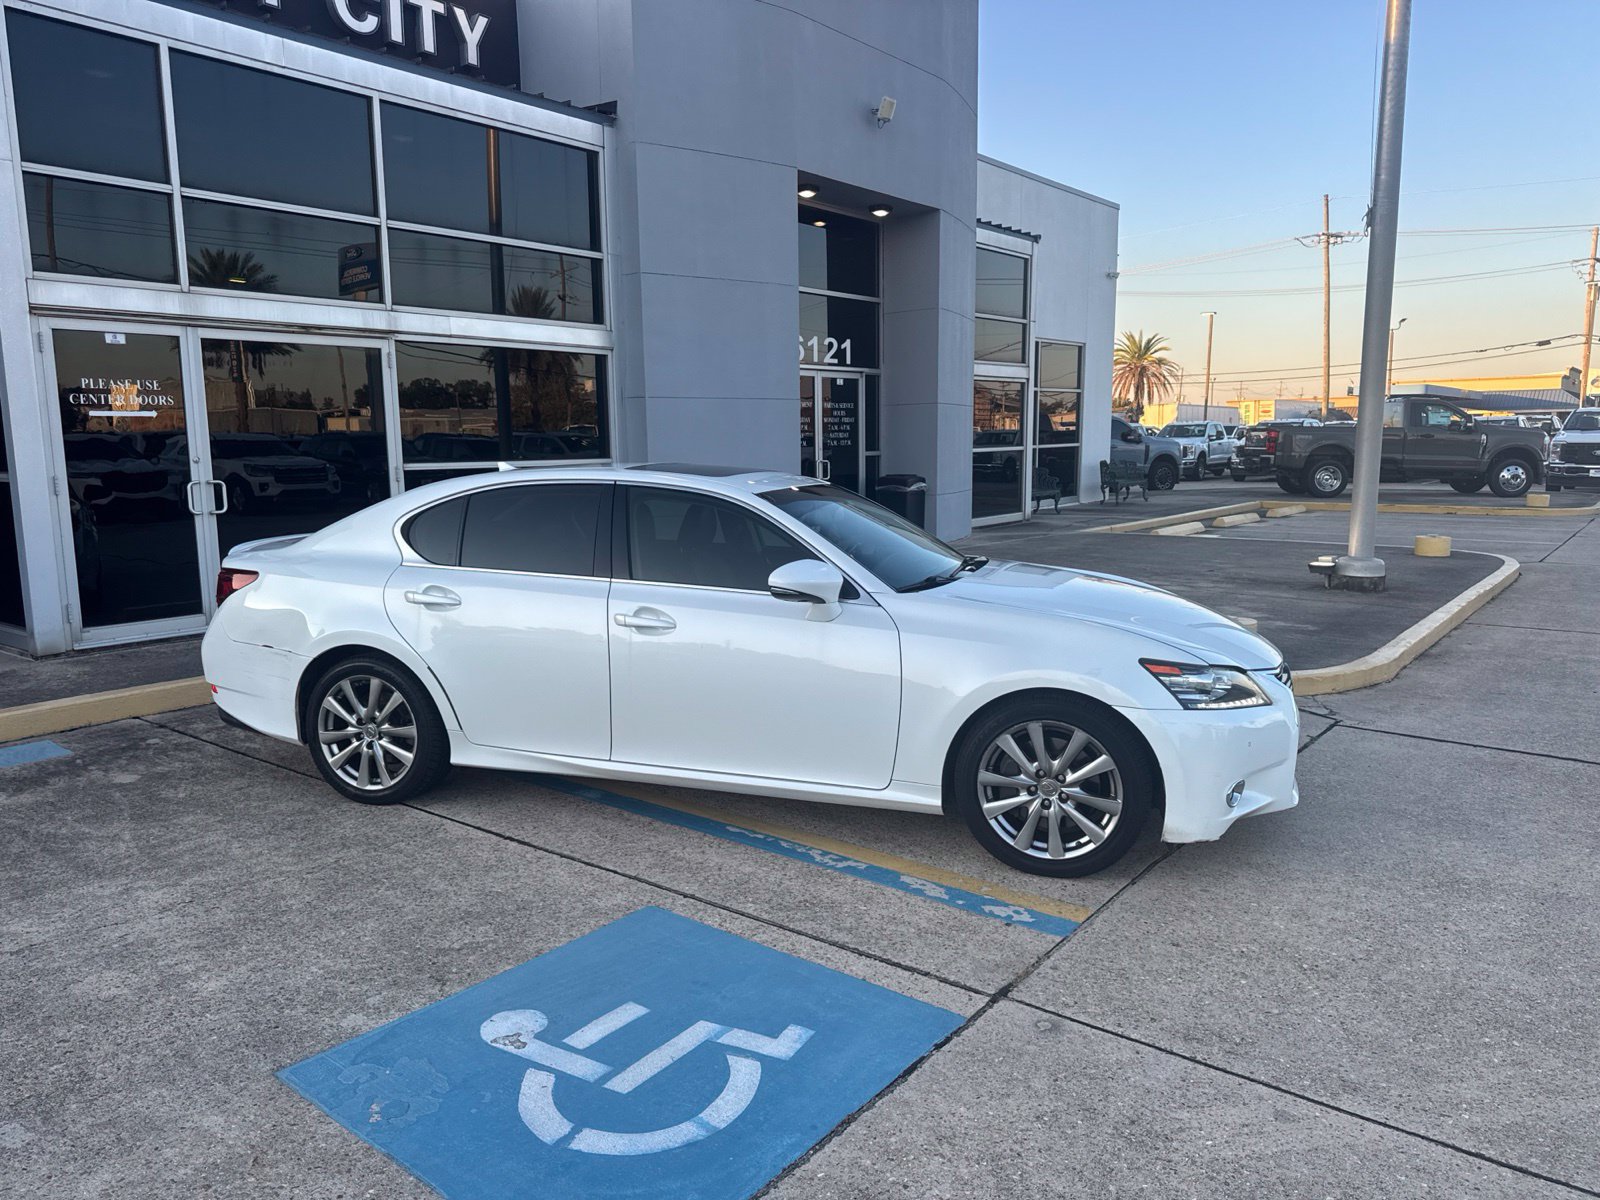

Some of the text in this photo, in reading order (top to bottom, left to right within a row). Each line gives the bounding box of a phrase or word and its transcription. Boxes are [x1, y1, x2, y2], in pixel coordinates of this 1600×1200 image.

[331, 0, 489, 67] CITY
[80, 378, 161, 391] PLEASE USE
[69, 393, 175, 406] CENTER DOORS
